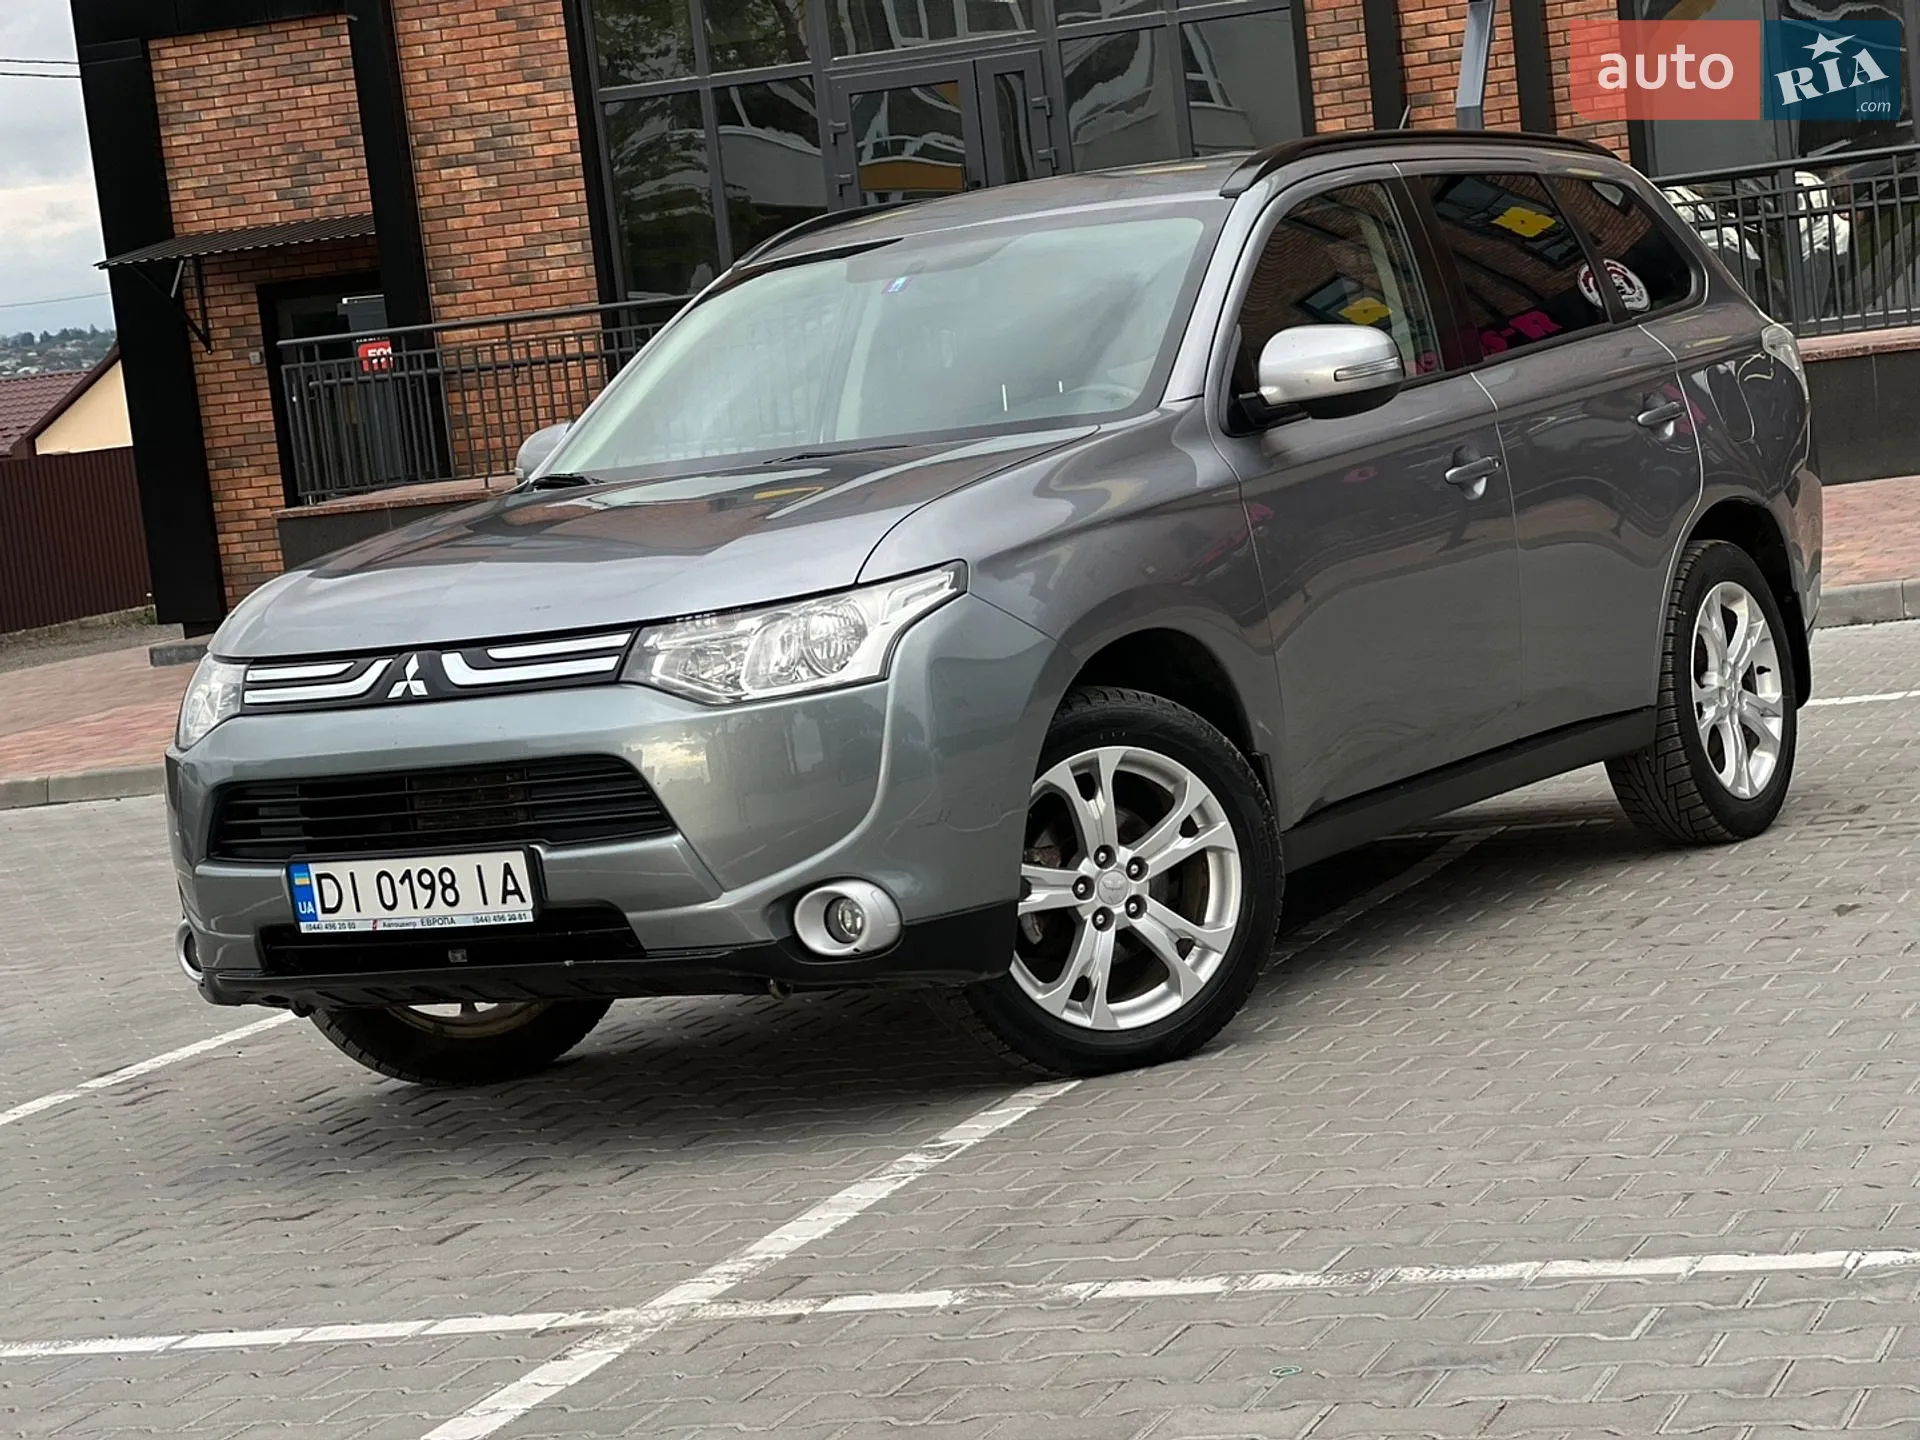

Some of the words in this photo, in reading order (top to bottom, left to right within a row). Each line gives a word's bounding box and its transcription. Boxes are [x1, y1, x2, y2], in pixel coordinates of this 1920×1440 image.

[315, 871, 361, 914] DI
[375, 866, 460, 911] 0198
[476, 862, 526, 906] IA
[298, 901, 316, 914] UA
[421, 917, 456, 926] ЕВРОПА
